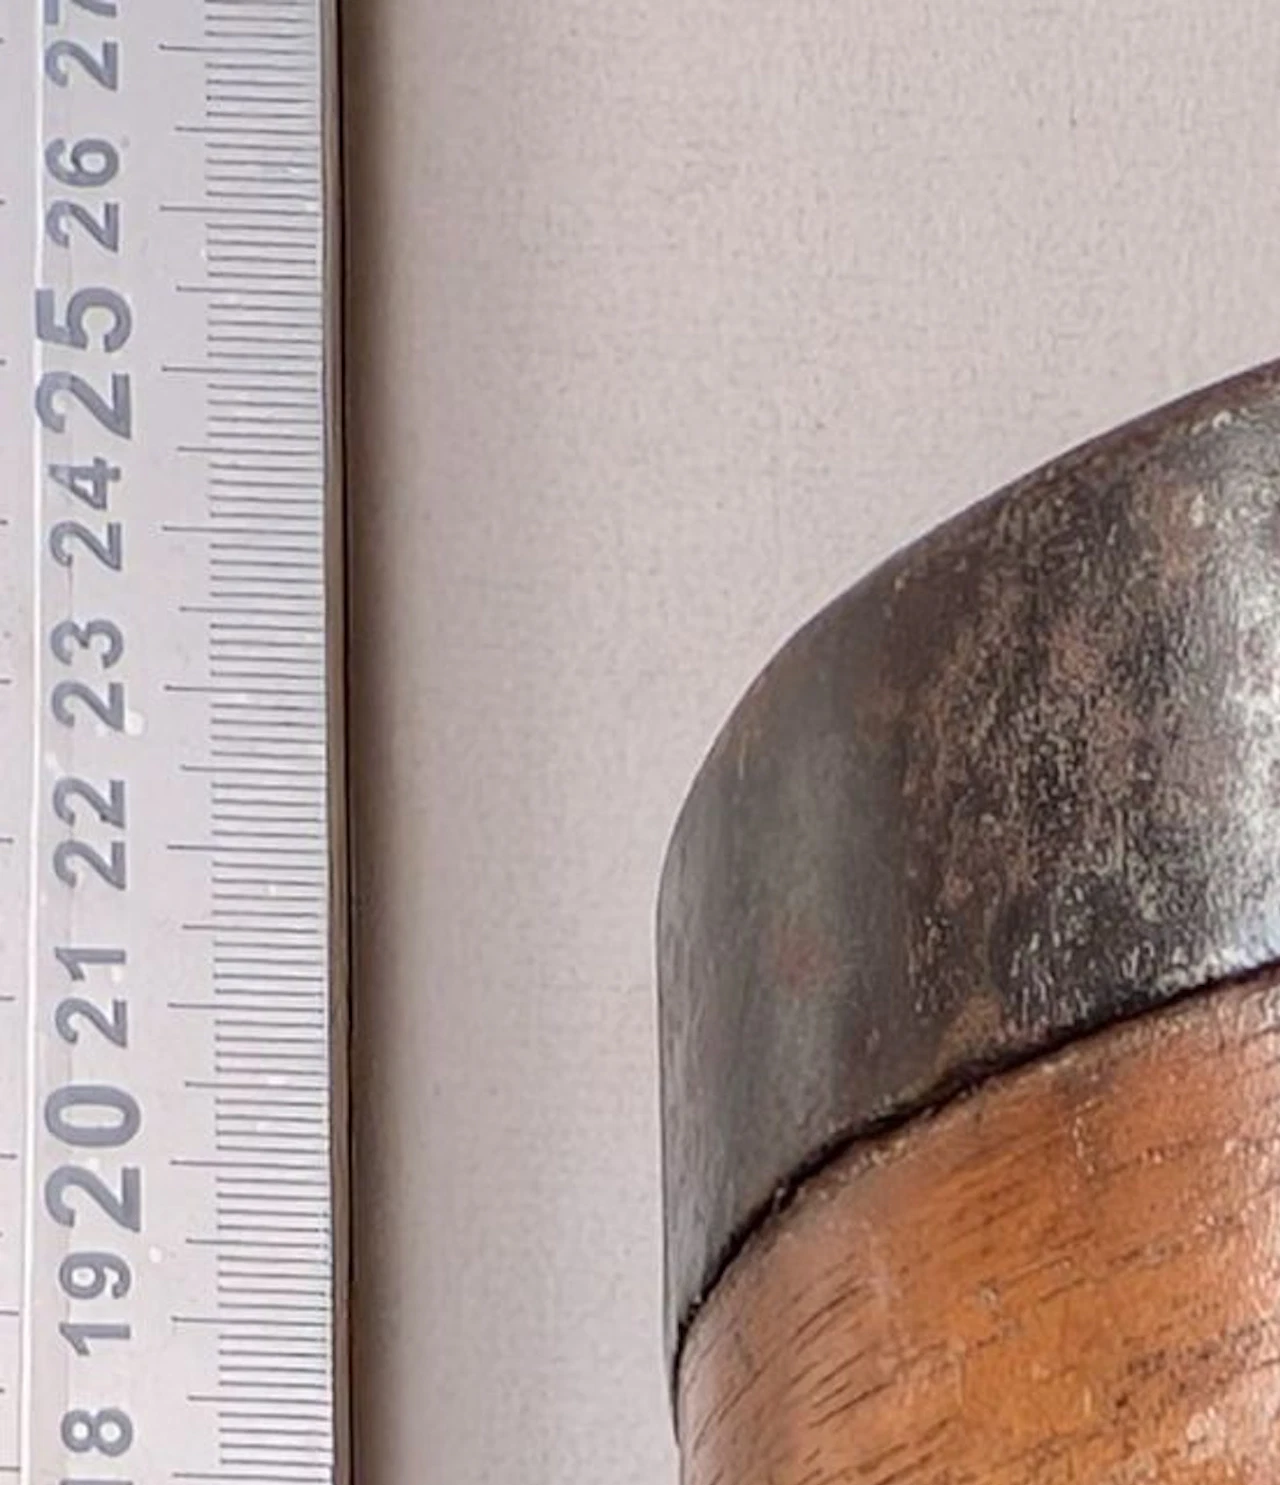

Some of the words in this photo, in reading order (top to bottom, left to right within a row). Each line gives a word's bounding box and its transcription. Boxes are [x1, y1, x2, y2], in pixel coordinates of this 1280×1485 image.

[44, 137, 120, 254] 26
[34, 287, 133, 441] 25
[47, 456, 123, 573] 24
[49, 619, 125, 733] 23
[51, 776, 127, 892] 22
[53, 946, 129, 1050] 21
[43, 1085, 142, 1234] 20
[57, 1251, 132, 1357] 19
